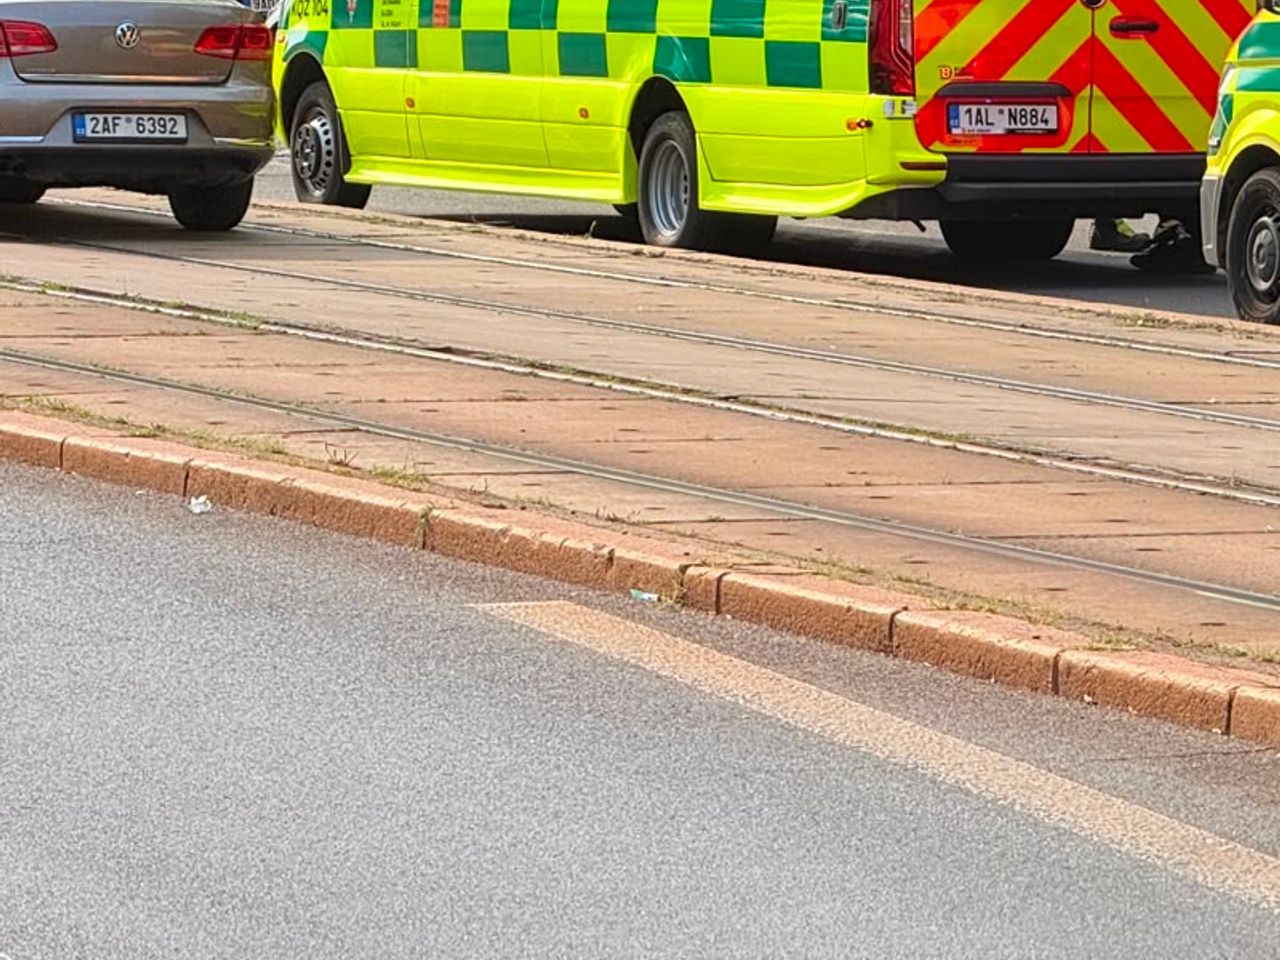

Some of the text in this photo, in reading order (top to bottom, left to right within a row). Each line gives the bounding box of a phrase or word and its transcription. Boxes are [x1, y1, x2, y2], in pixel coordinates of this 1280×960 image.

[90, 116, 178, 135] 2AF 6392
[964, 107, 995, 126] 1AL
[1008, 107, 1049, 127] N884
